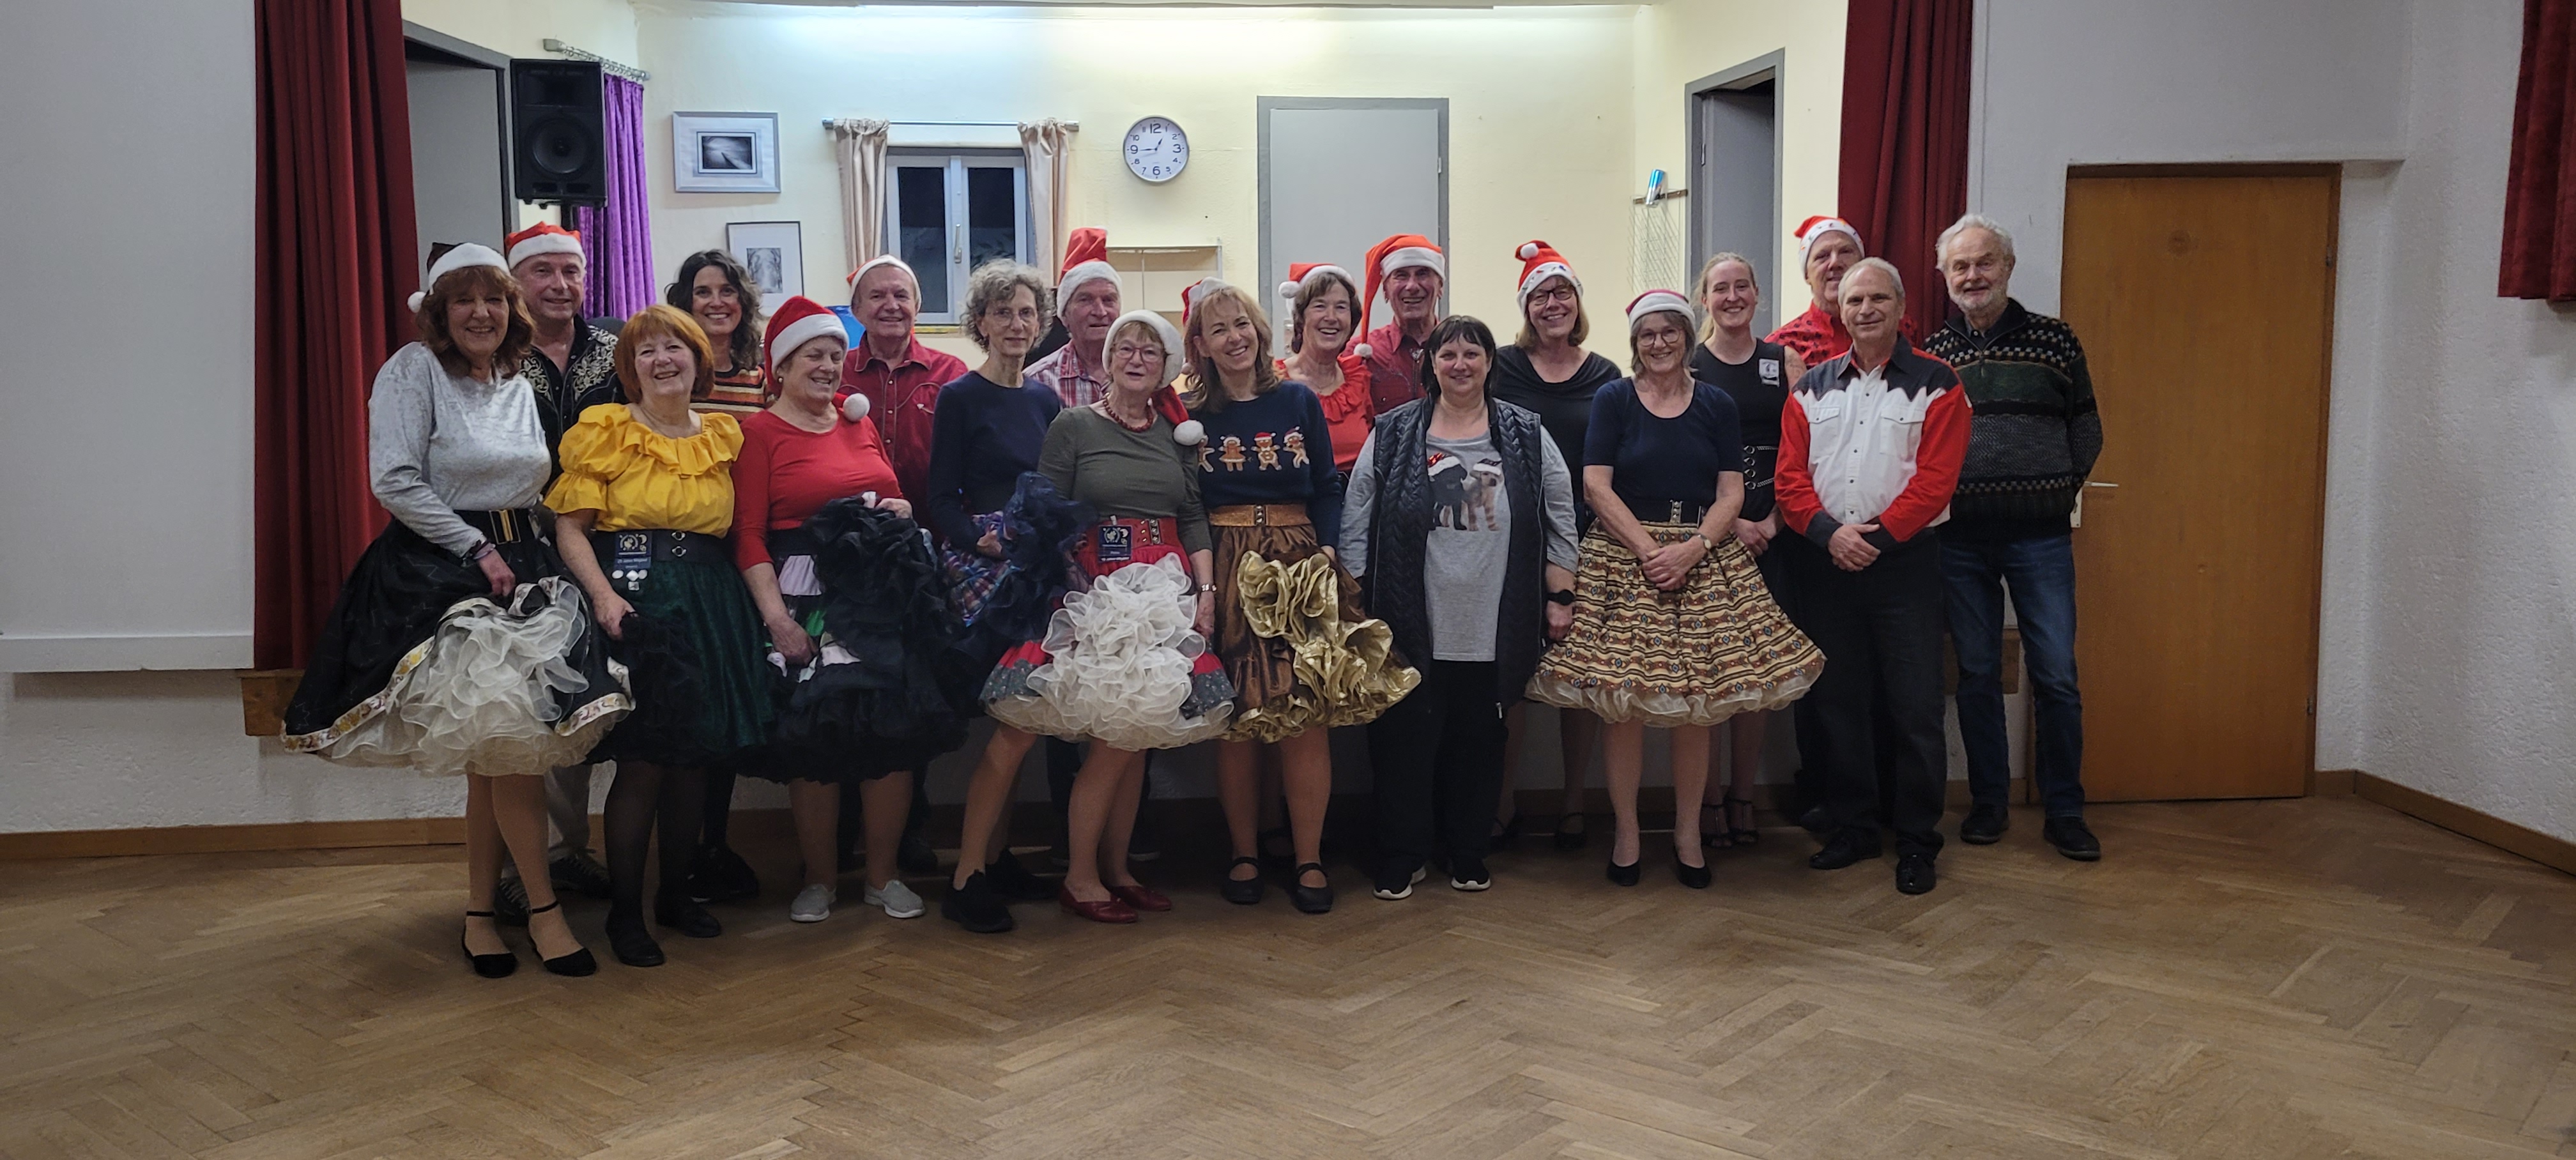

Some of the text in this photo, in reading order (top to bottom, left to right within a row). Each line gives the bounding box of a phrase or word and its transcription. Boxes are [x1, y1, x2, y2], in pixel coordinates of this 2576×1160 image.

[1150, 123, 1162, 134] 12
[1130, 145, 1138, 154] 9
[1173, 144, 1181, 153] 3
[1153, 166, 1160, 176] 6
